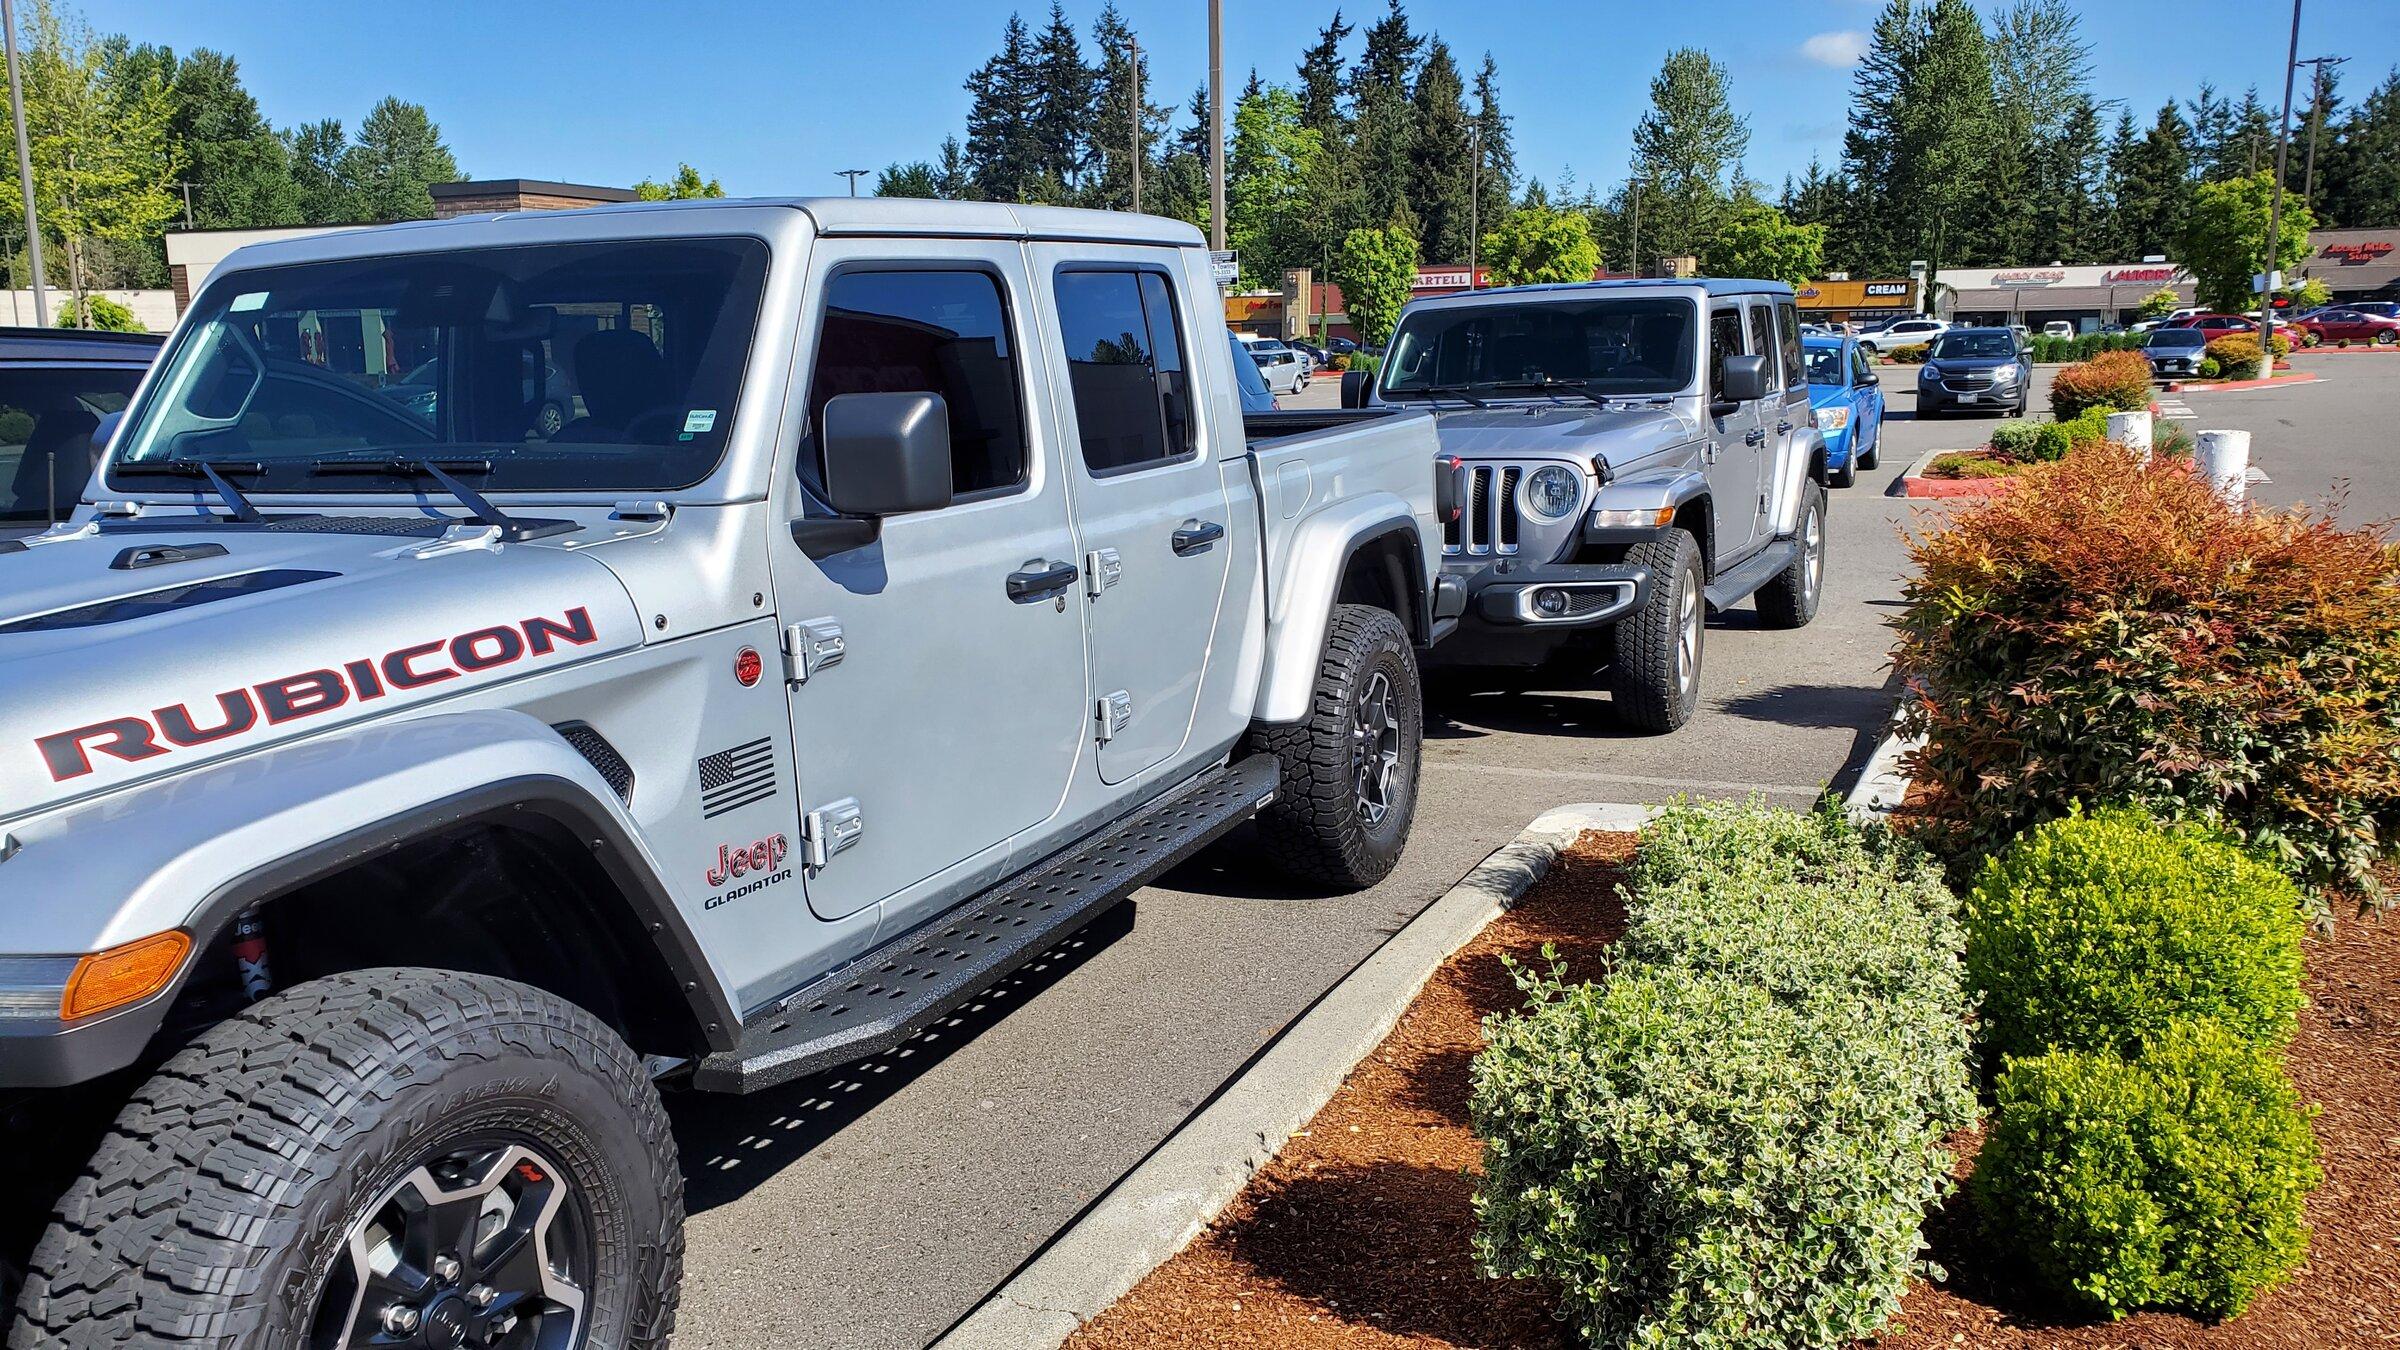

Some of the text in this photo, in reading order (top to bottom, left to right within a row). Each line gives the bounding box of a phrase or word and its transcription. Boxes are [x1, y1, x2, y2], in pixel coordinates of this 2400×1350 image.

[1217, 263, 1236, 271] Towing
[1413, 275, 1466, 286] ARTELL
[1867, 284, 1906, 295] CREAM
[34, 605, 598, 782] RUBICON
[706, 833, 789, 887] Jeep
[704, 869, 792, 910] GLADIATOR
